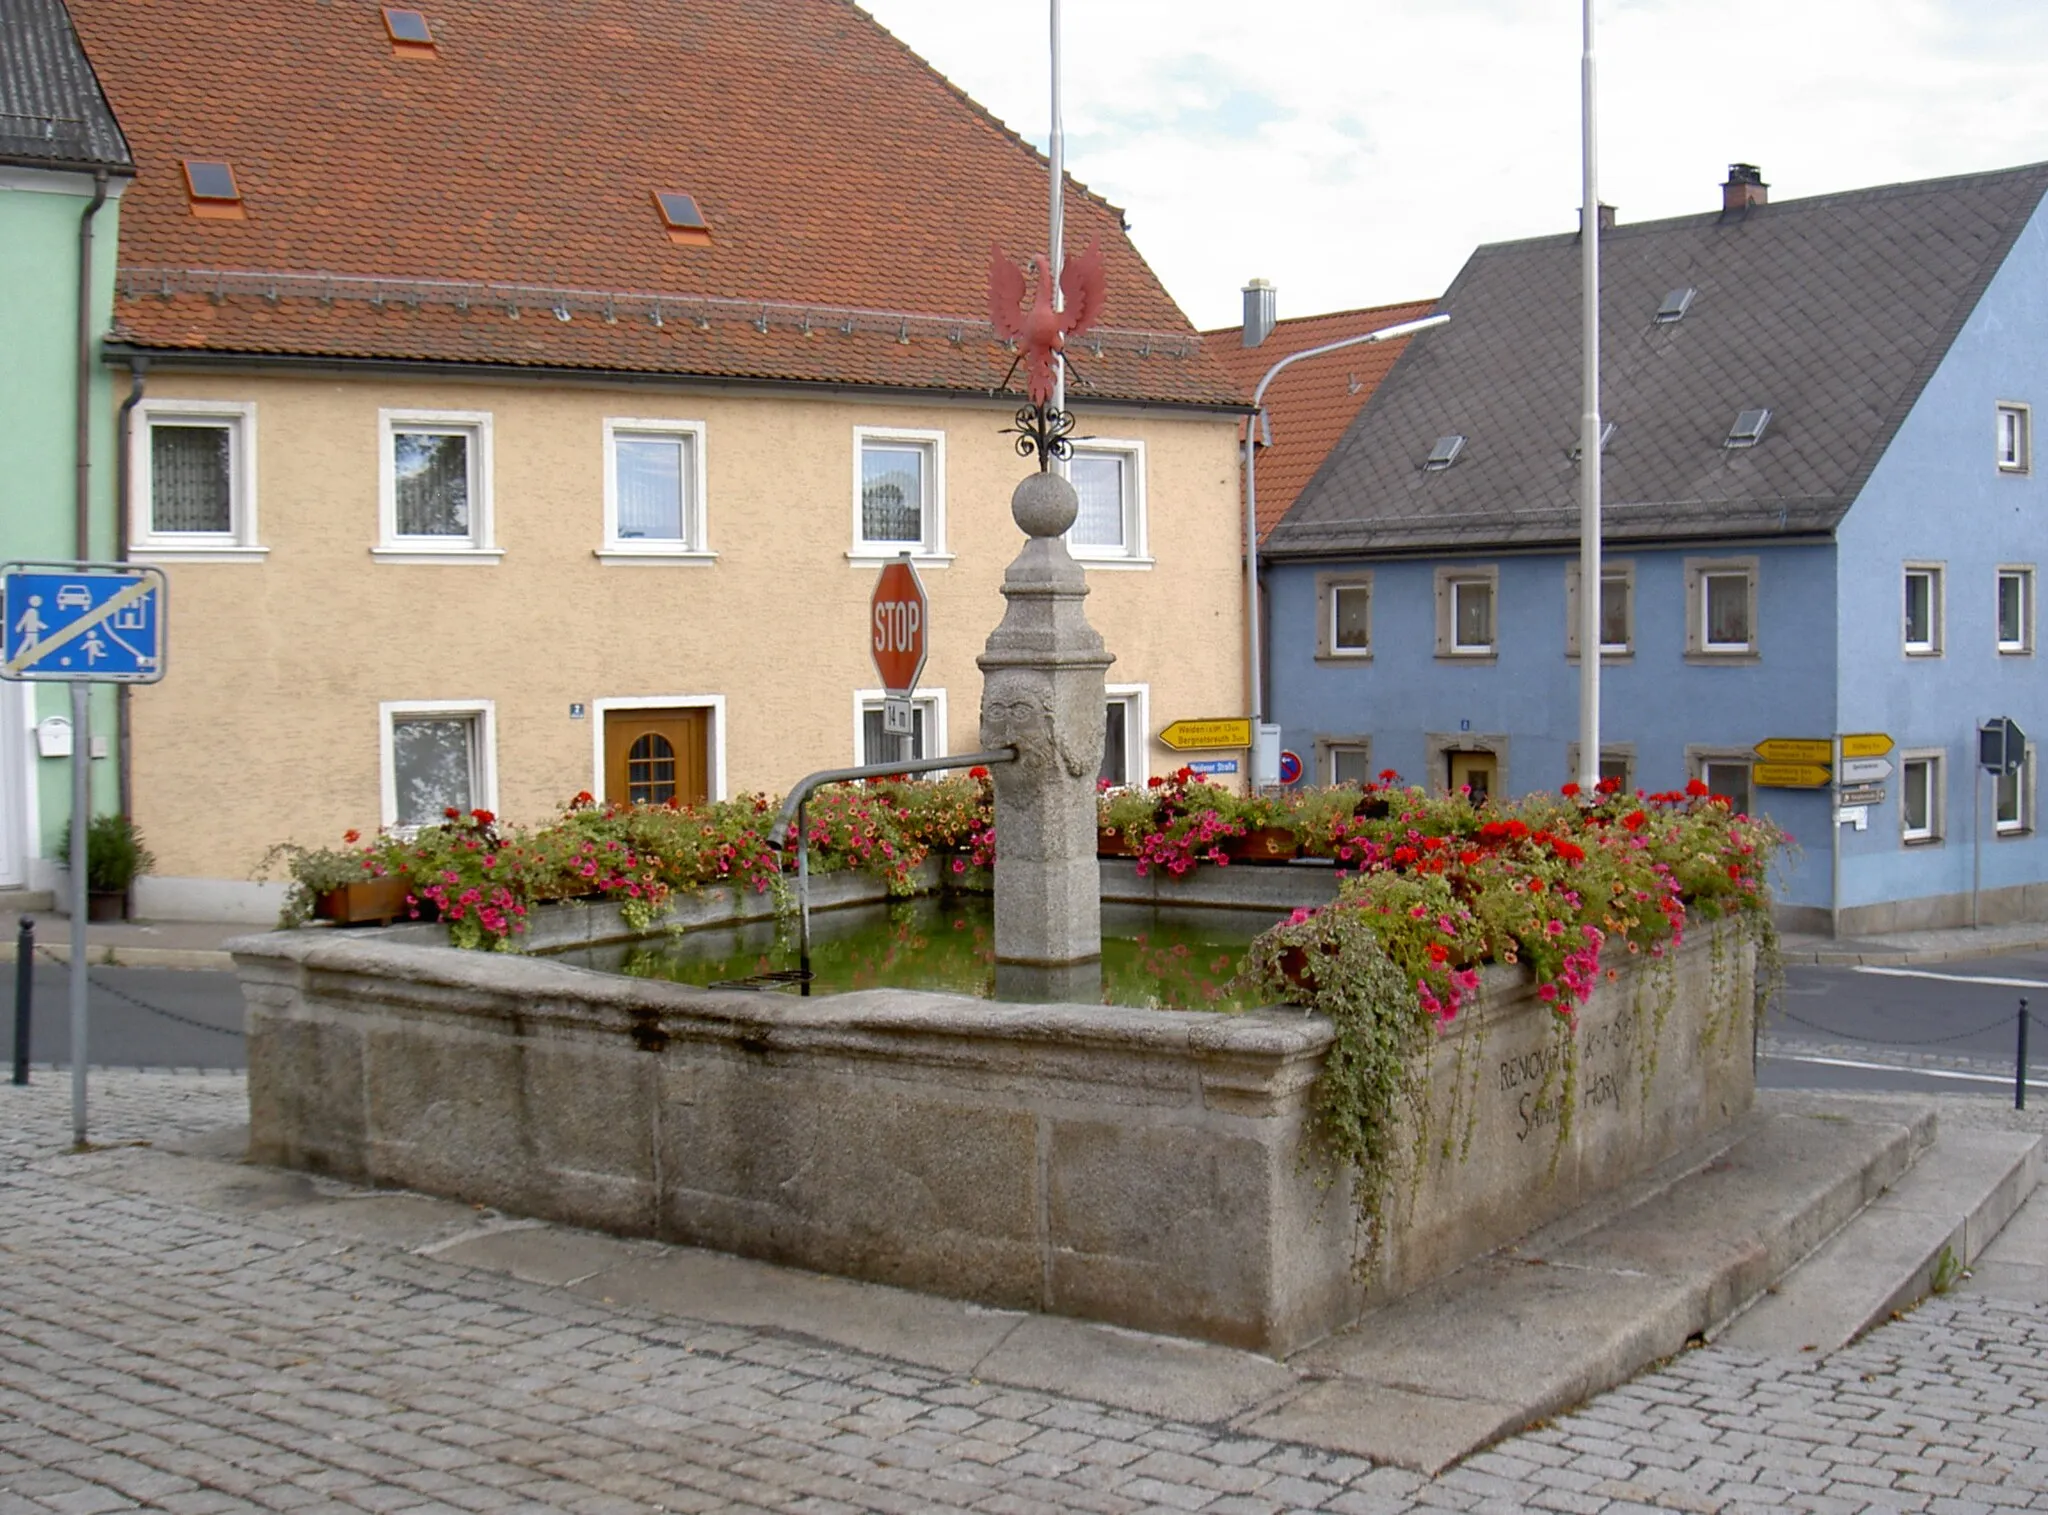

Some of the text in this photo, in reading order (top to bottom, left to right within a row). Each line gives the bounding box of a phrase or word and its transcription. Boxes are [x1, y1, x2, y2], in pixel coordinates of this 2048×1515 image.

[875, 600, 920, 652] STOP
[1178, 725, 1204, 734] Weiden
[1217, 761, 1235, 772] Straße
